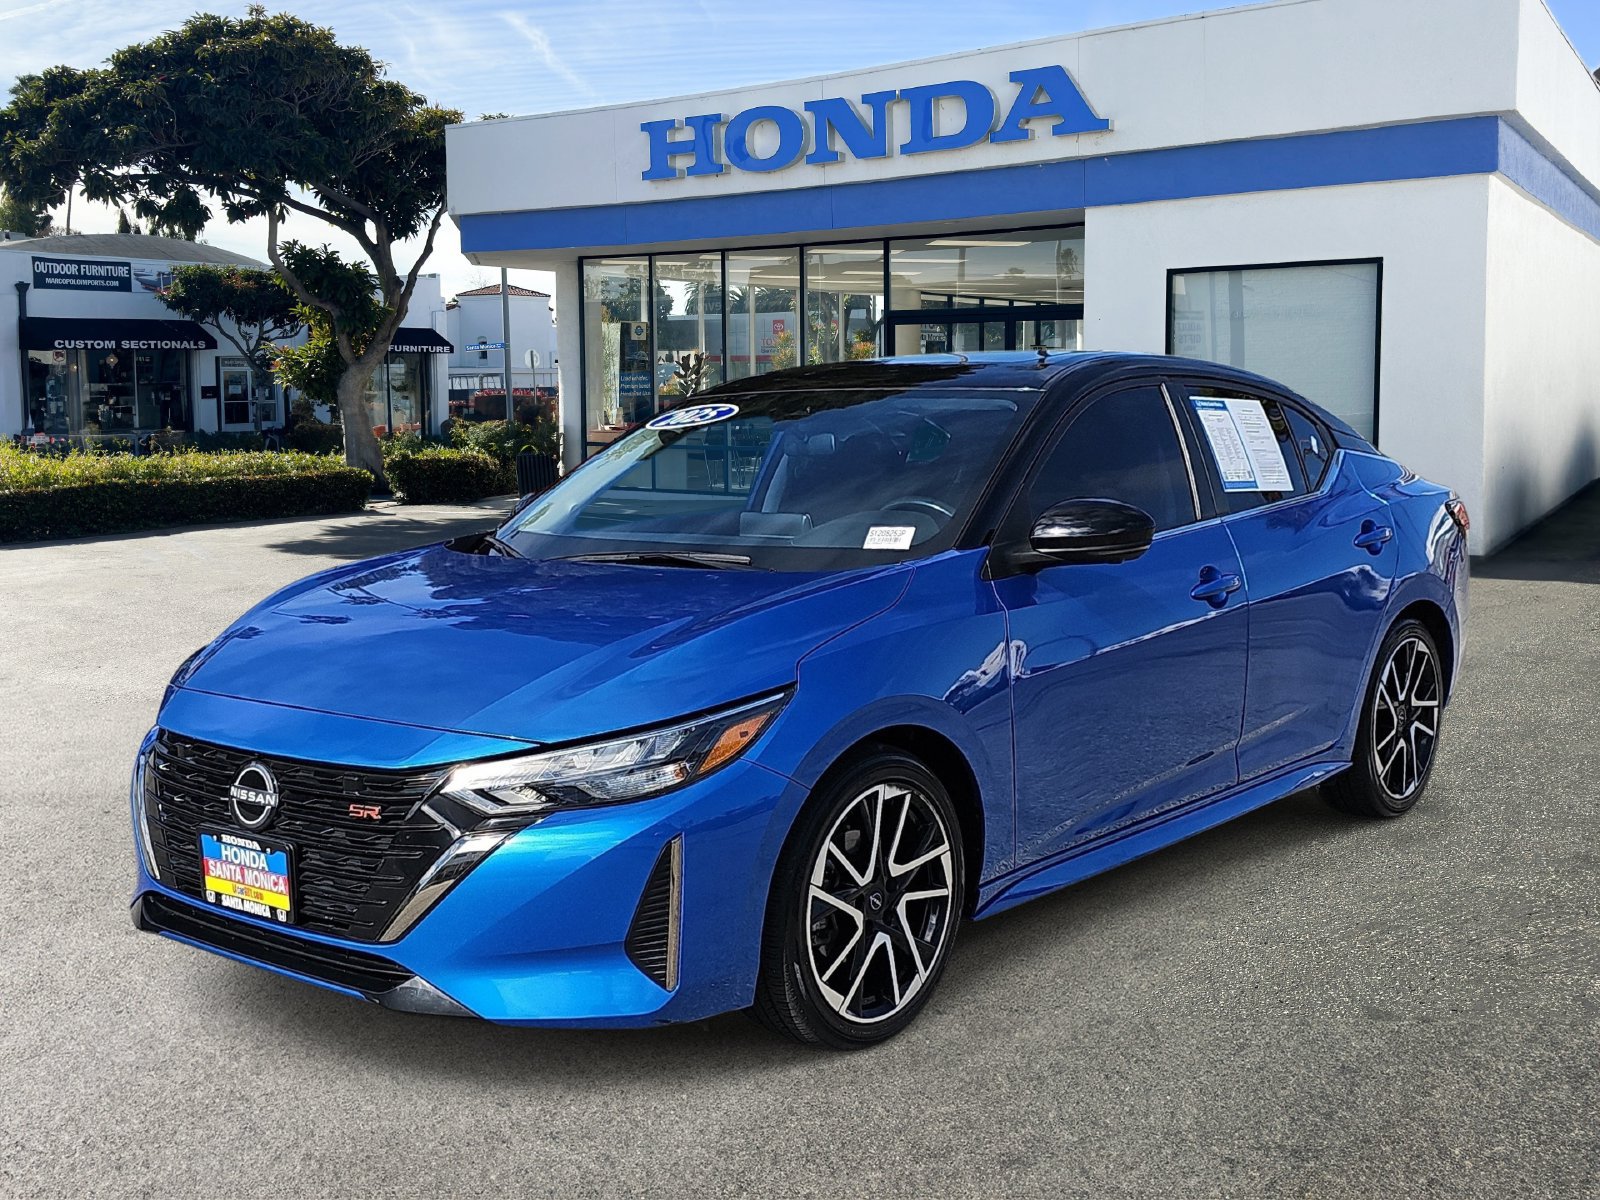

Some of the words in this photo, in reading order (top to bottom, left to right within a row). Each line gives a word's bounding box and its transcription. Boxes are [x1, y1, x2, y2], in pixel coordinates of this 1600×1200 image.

[640, 64, 1112, 181] HONDA
[34, 261, 79, 276] OUTDOOR
[80, 264, 130, 278] FURNITURE
[45, 277, 119, 287] MARCOPOLOIMPORTS.COM
[54, 339, 116, 349] CUSTOM
[121, 340, 206, 349] SECTIONALS
[388, 344, 451, 353] FURNITURE
[230, 787, 276, 805] NISSAN
[349, 803, 382, 820] SR
[221, 834, 262, 851] HONDA
[221, 843, 269, 871] HONDA
[208, 860, 243, 884] SANTA
[244, 869, 287, 894] MONICA
[221, 894, 243, 911] SANTA
[243, 900, 272, 918] MONICA
